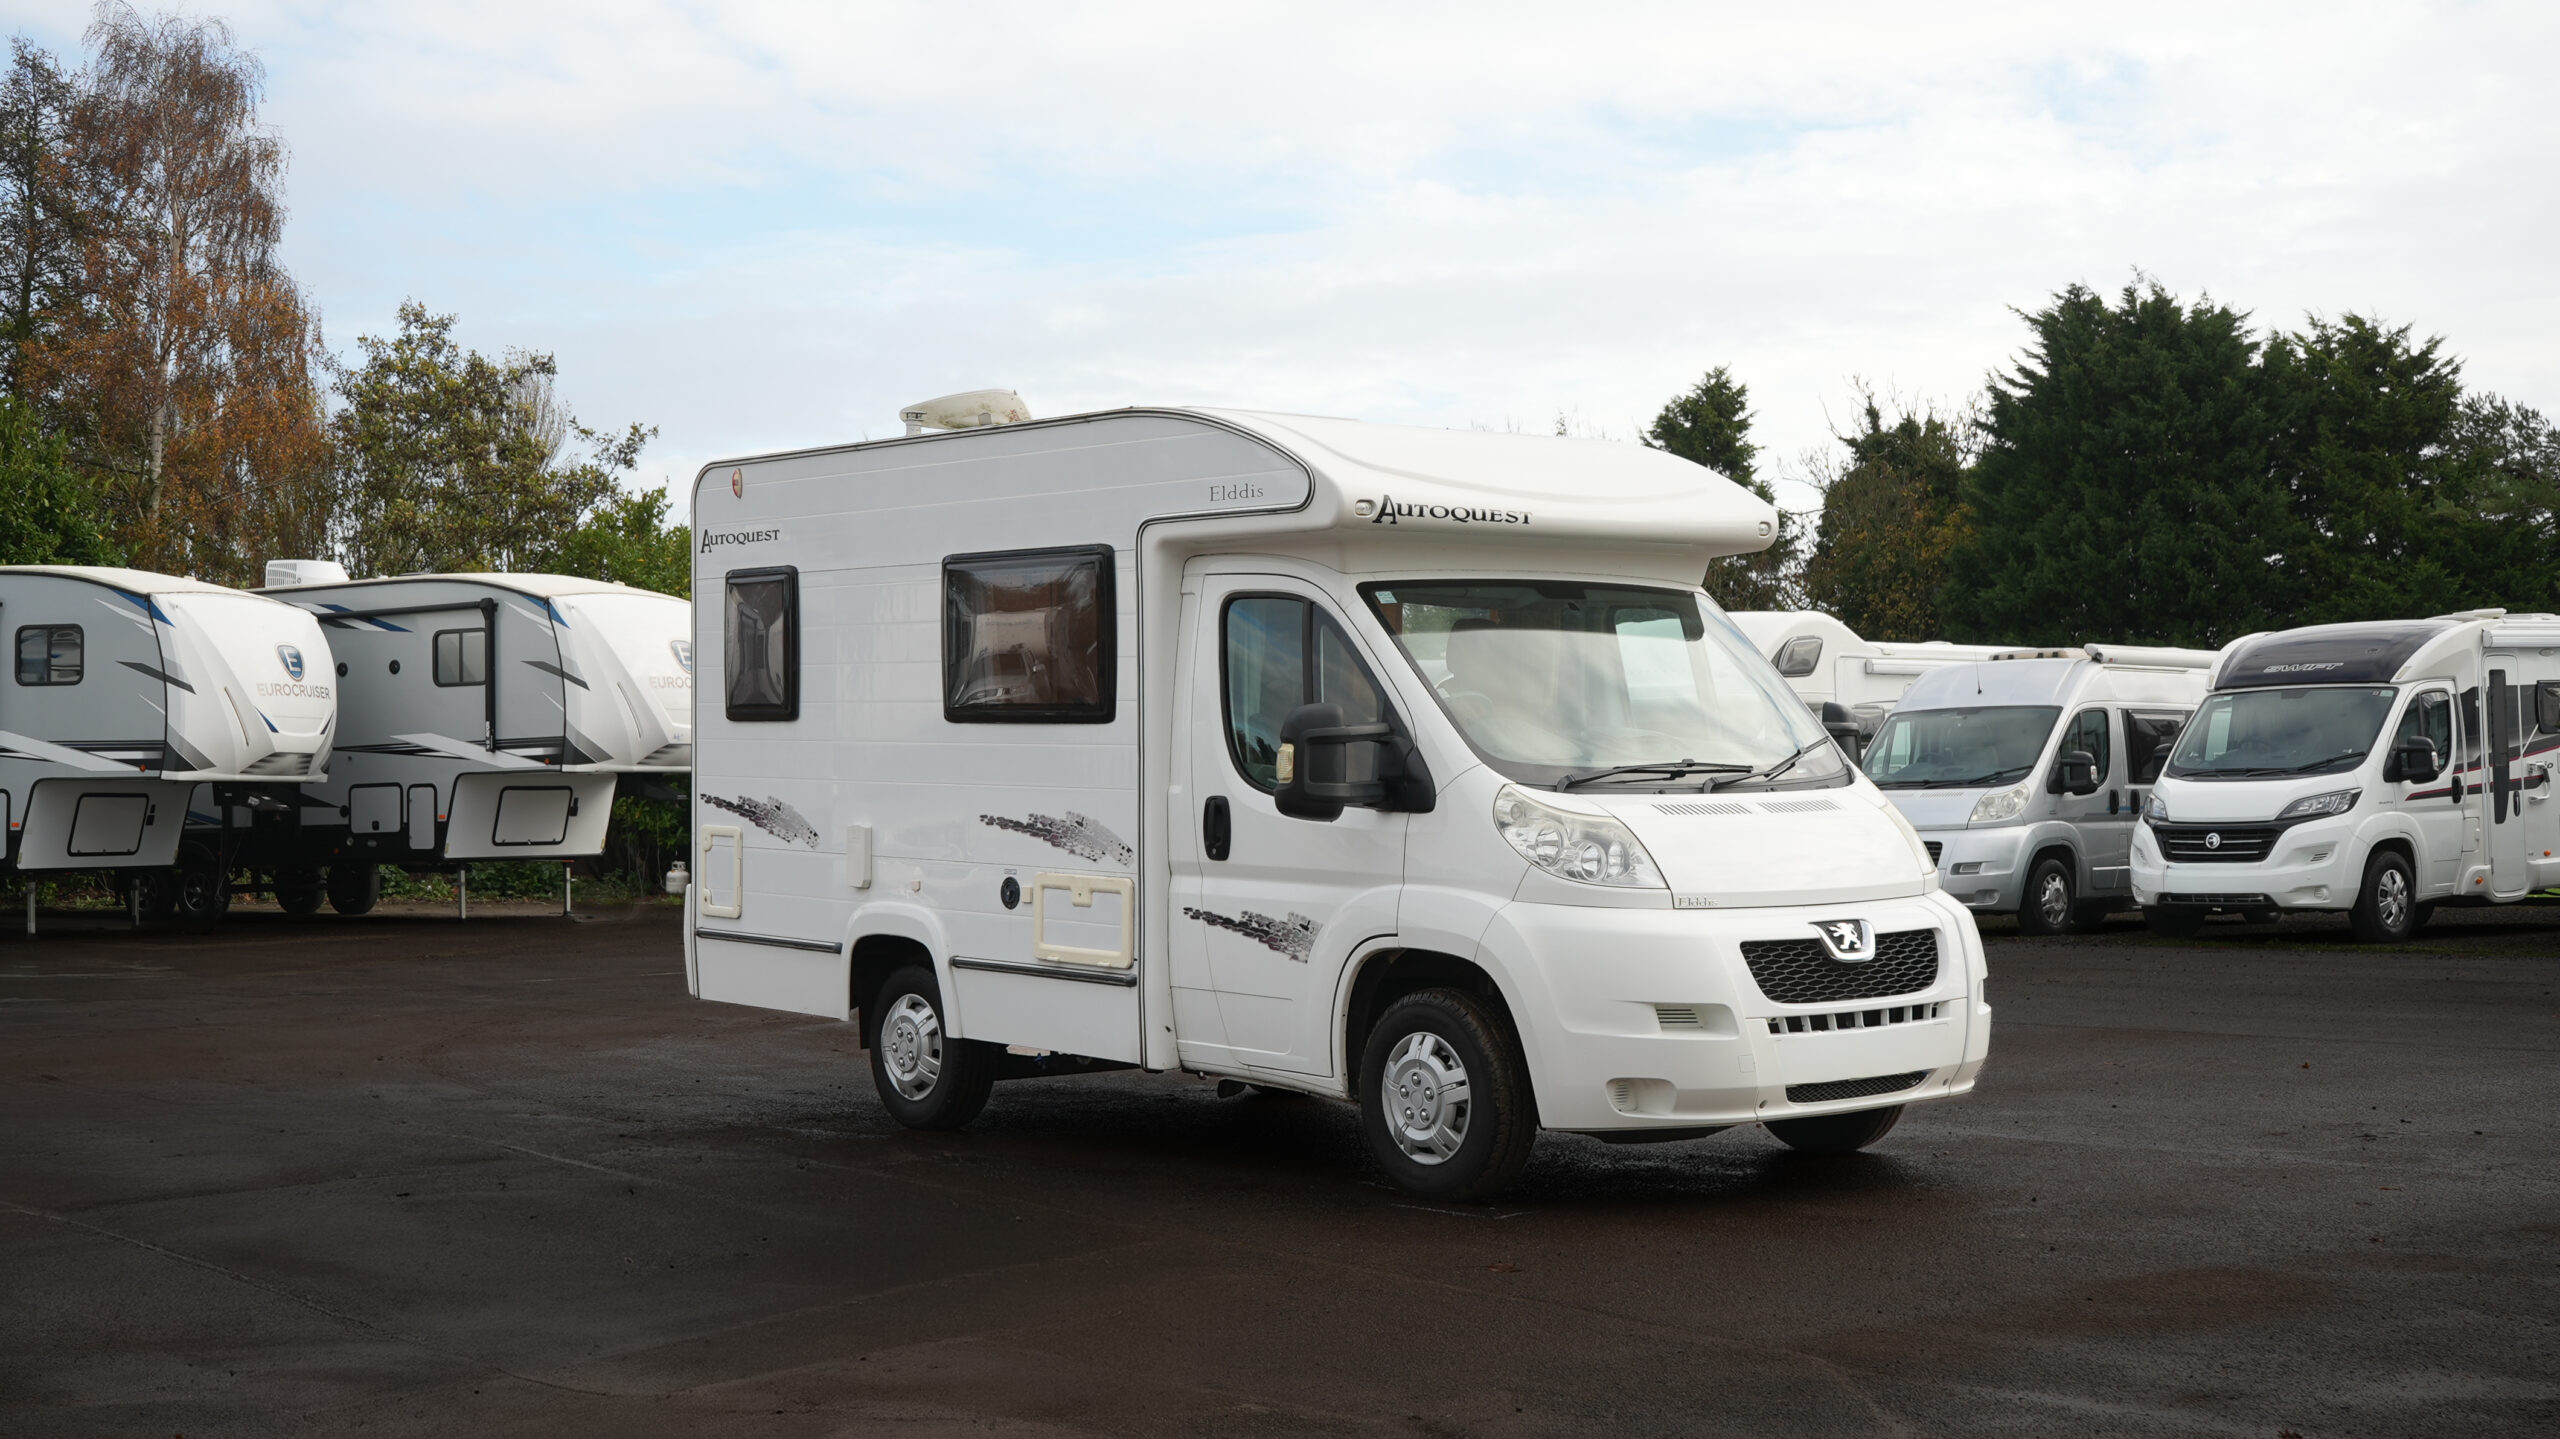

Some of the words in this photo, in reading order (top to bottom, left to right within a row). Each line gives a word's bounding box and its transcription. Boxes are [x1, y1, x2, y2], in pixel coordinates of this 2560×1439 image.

[1209, 483, 1264, 502] Elddis
[1372, 494, 1533, 525] AUTOQUEST
[700, 529, 780, 553] AUTOQUEST
[2263, 662, 2345, 673] SWIFT
[256, 682, 331, 700] EUROCRUISER
[1678, 896, 1719, 908] Elddis
